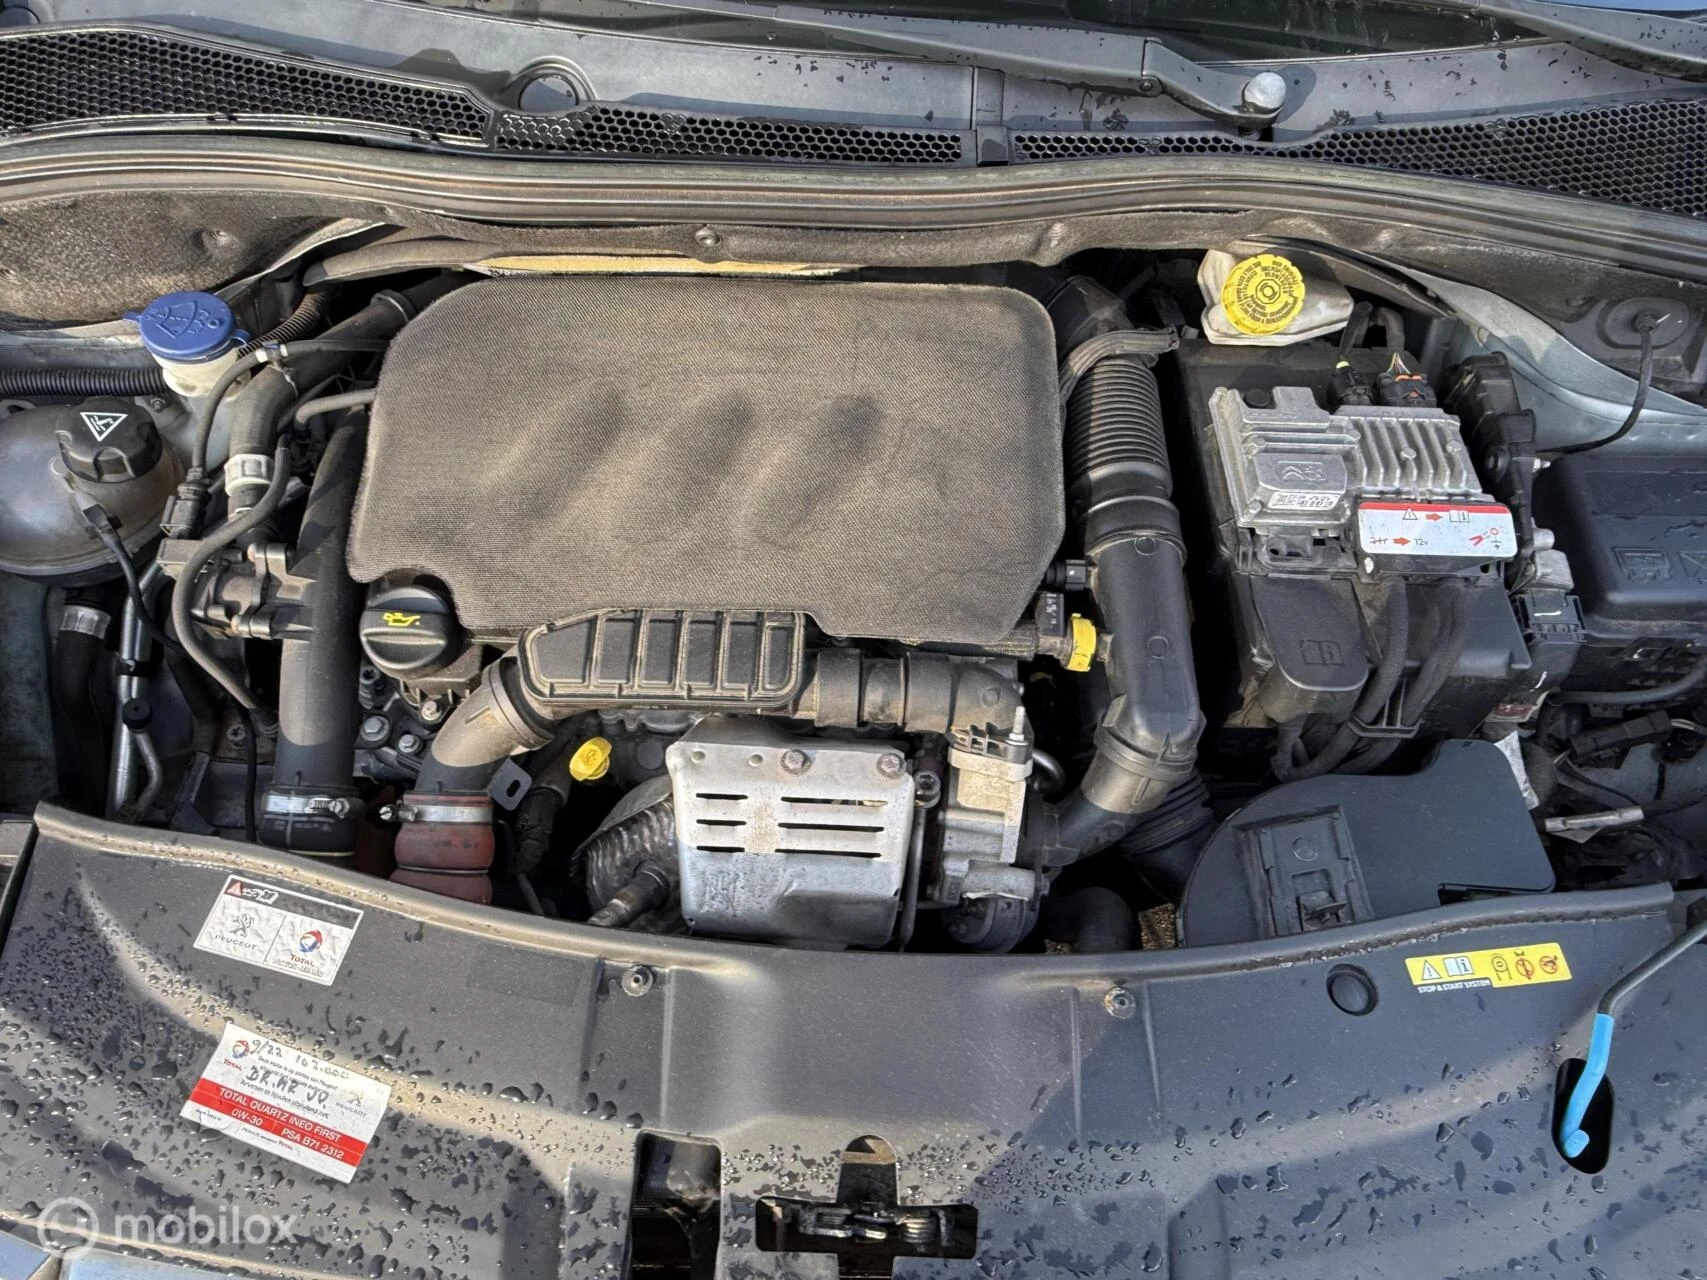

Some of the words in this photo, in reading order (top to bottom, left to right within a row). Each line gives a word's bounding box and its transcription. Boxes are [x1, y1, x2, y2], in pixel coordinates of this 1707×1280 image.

[215, 934, 257, 950] PEUGEOT
[290, 953, 315, 967] TOTAL
[223, 1059, 243, 1071] TOTAL
[219, 1088, 248, 1105] TOTAL
[249, 1100, 289, 1122] QUARTZ
[289, 1115, 314, 1132] INEO
[313, 1125, 342, 1142] FIRST
[335, 1102, 368, 1118] PEUGEOT
[231, 1108, 264, 1126] 0W-30
[281, 1128, 301, 1142] PSA
[302, 1136, 320, 1150] B71
[320, 1144, 345, 1159] 2312
